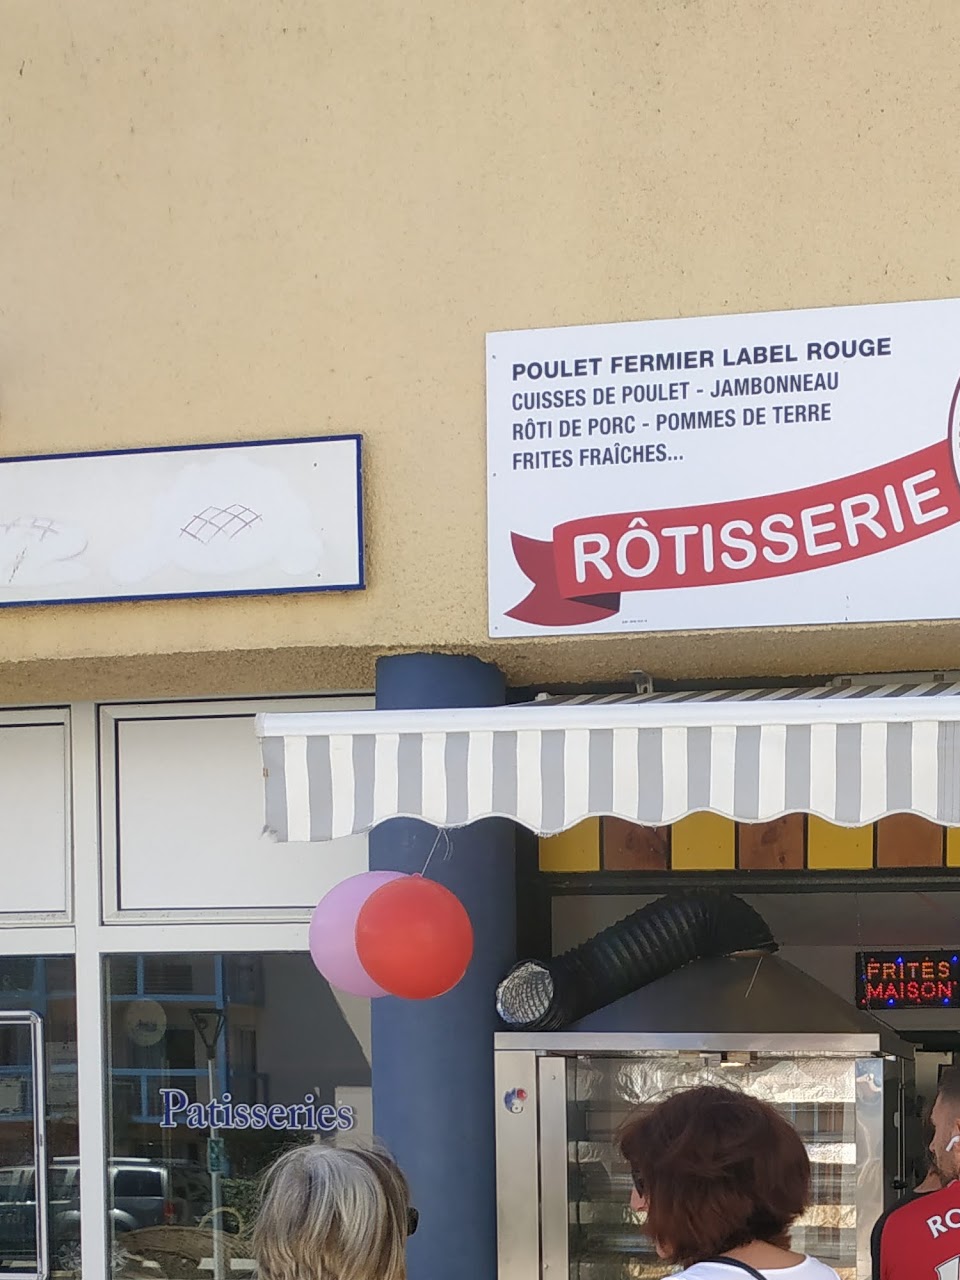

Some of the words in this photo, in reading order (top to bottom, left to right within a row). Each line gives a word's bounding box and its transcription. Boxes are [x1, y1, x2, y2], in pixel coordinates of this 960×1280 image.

[512, 358, 602, 381] POULET
[610, 350, 715, 374] FERMIER
[722, 344, 798, 368] LABEL
[806, 338, 892, 362] ROUGE
[512, 388, 586, 410] CUISSES
[594, 387, 616, 406] DE
[622, 382, 690, 404] POULET
[710, 372, 840, 398] JAMBONNEAU
[512, 420, 554, 441] RÔTI
[559, 419, 582, 438] DE
[588, 415, 636, 436] PORC
[656, 408, 737, 432] POMMES
[743, 407, 766, 426] DE
[772, 402, 832, 424] TERRE
[512, 450, 574, 470] FRITES
[573, 469, 950, 584] RÔTISSERIE
[866, 960, 950, 980] FRITES
[866, 981, 952, 999] MAISON
[159, 1088, 354, 1131] Patisseries
